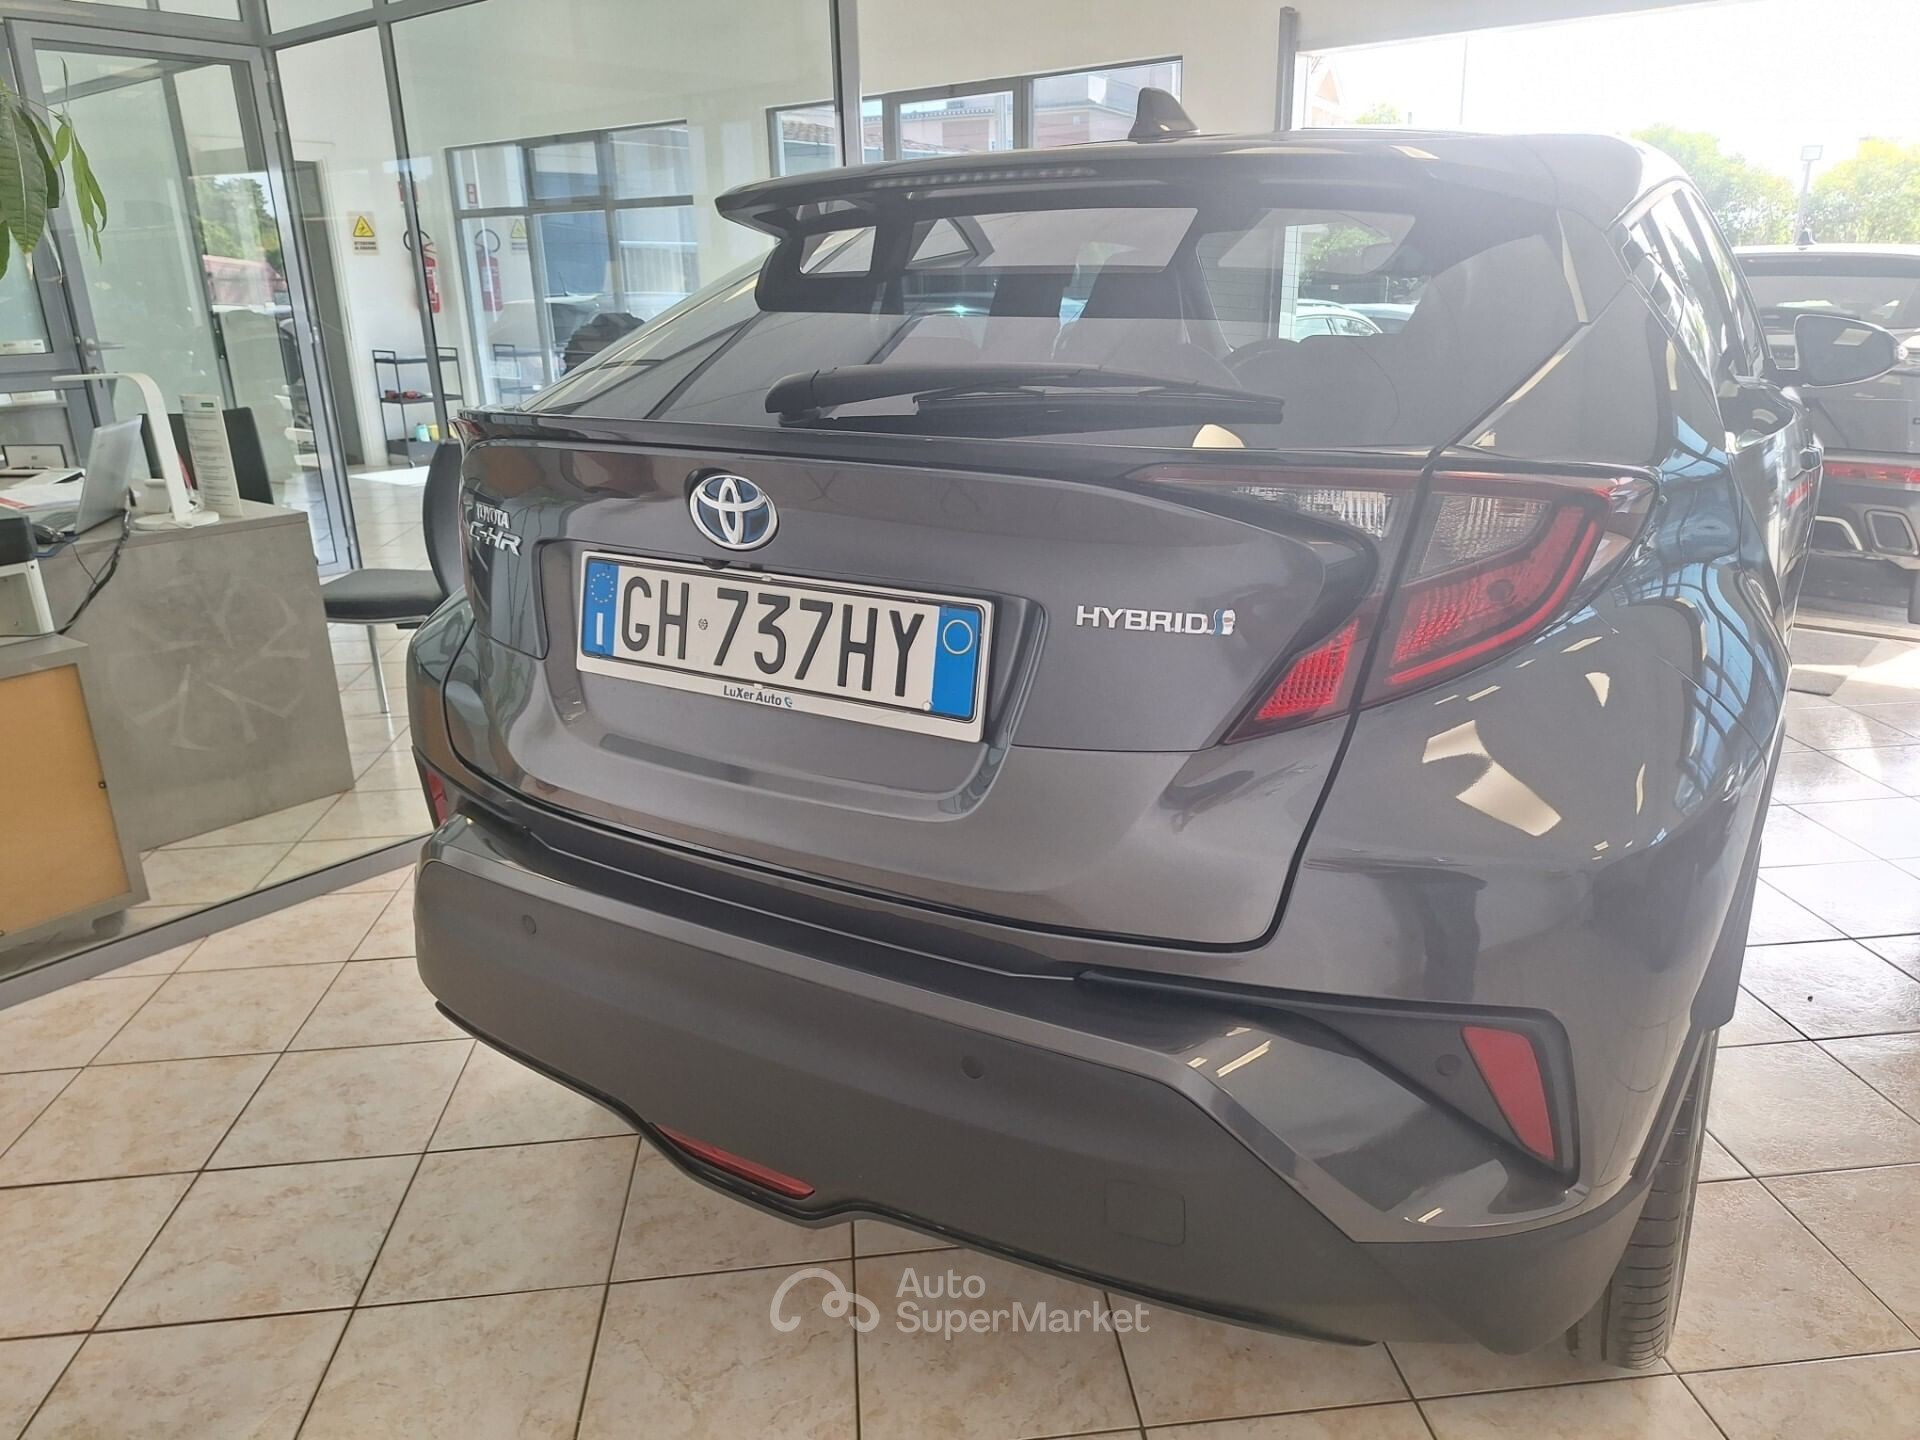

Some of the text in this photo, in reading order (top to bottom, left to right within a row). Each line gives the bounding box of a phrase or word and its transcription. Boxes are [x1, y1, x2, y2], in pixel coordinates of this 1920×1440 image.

[475, 502, 510, 529] TOYOTA
[470, 521, 521, 557] C-HR
[1075, 605, 1209, 634] HYBRID
[621, 576, 926, 698] GH 737HY
[723, 685, 782, 706] LuXer Auto
